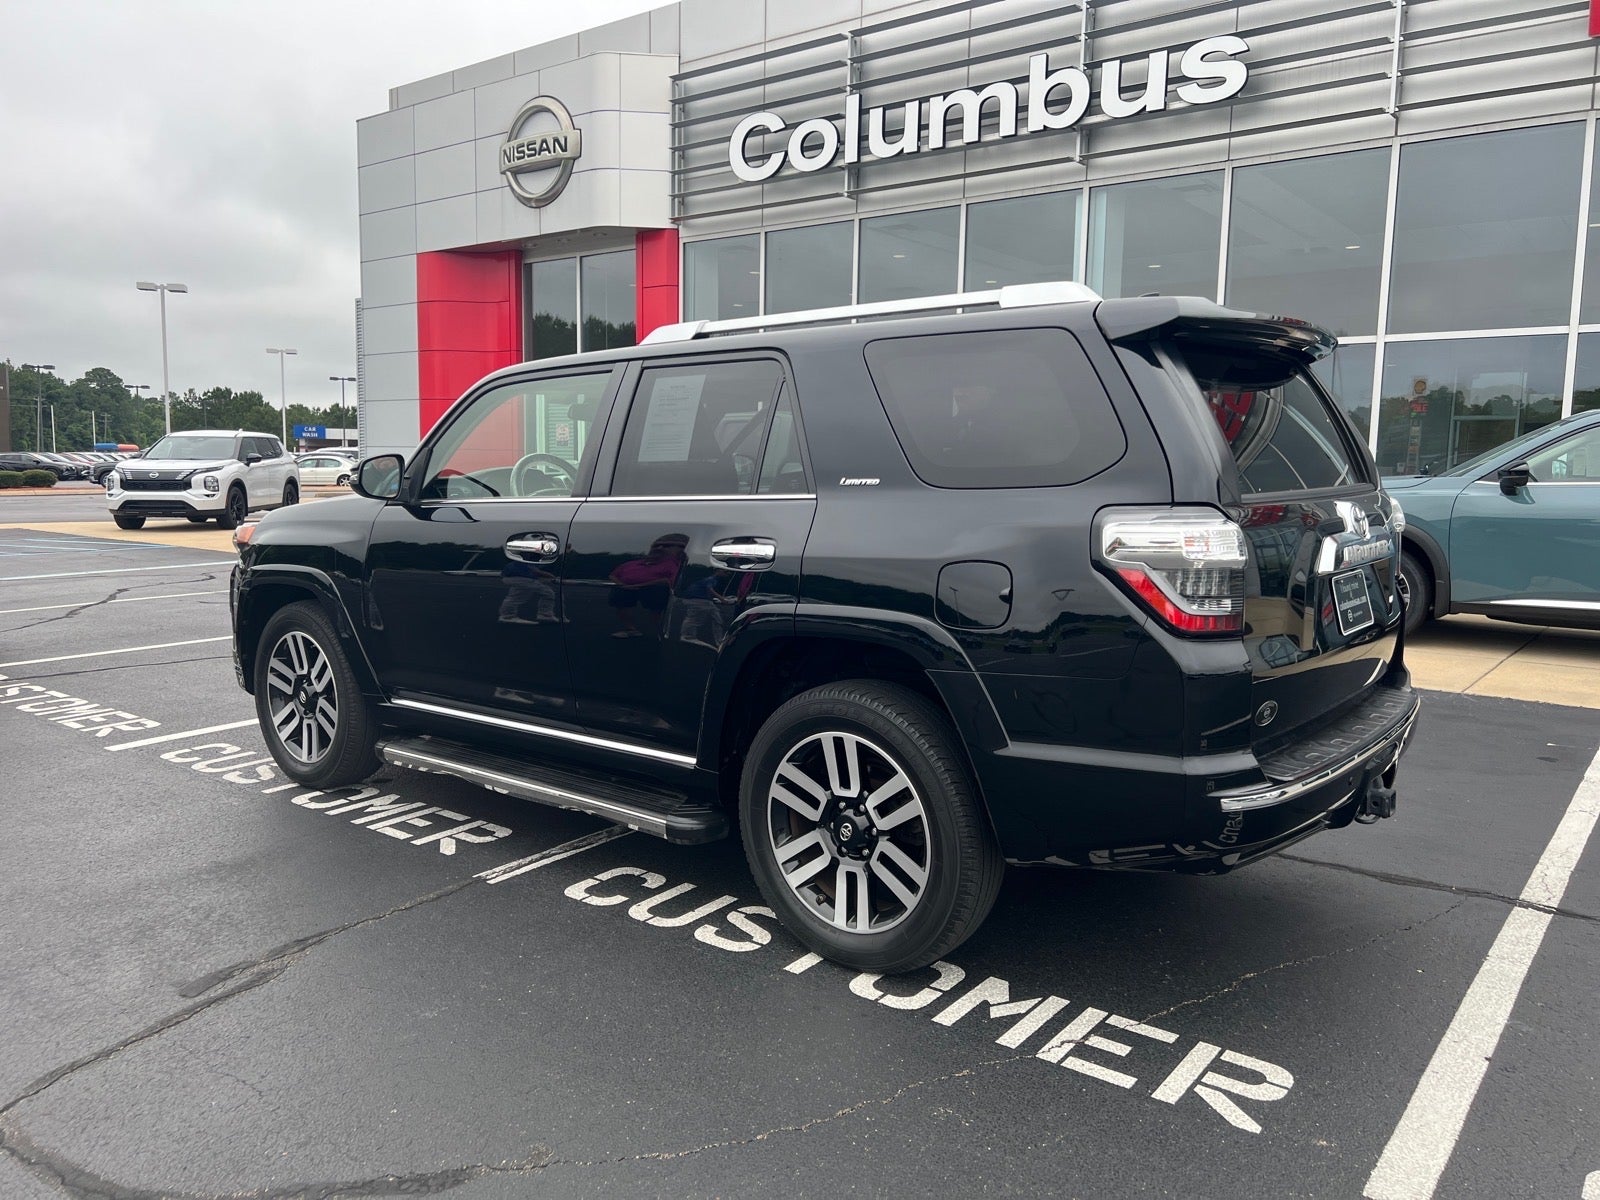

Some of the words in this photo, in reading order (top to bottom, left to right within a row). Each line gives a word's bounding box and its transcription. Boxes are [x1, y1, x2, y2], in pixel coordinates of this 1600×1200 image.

[502, 135, 568, 165] NISSAN
[728, 34, 1250, 183] Columbus
[0, 673, 162, 737] STOMER
[160, 743, 513, 856] CUSOMER
[563, 866, 1296, 1135] CUSOMER
